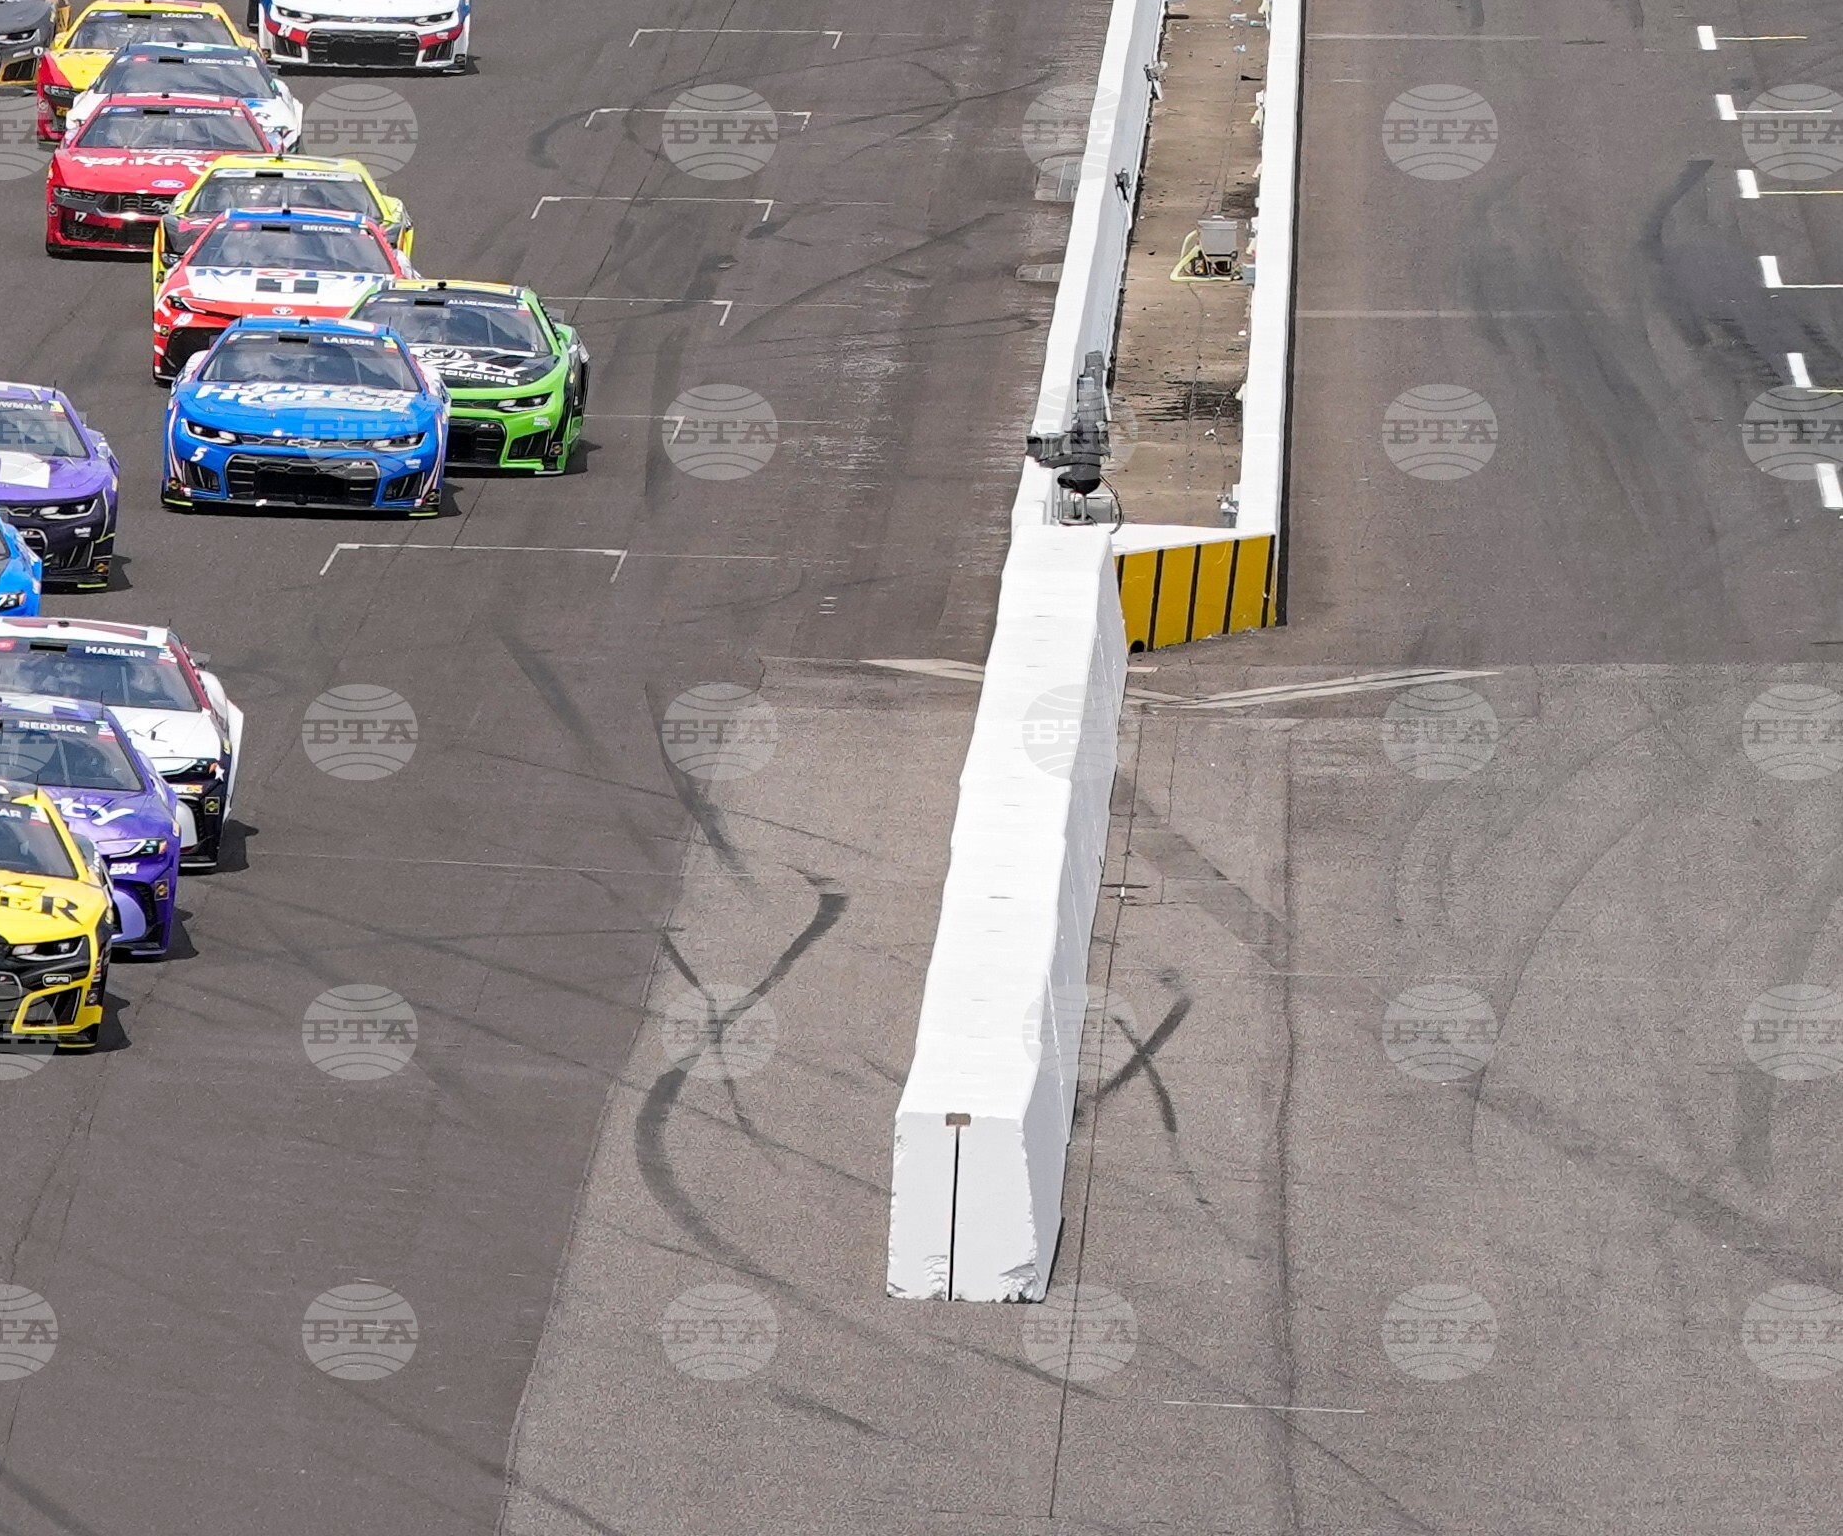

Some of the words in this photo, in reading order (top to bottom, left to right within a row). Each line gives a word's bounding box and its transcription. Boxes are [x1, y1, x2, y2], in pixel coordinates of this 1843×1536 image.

[323, 336, 375, 347] LARSON
[190, 446, 208, 463] 5
[84, 645, 146, 658] HAMLIN
[17, 720, 88, 734] REDDICK
